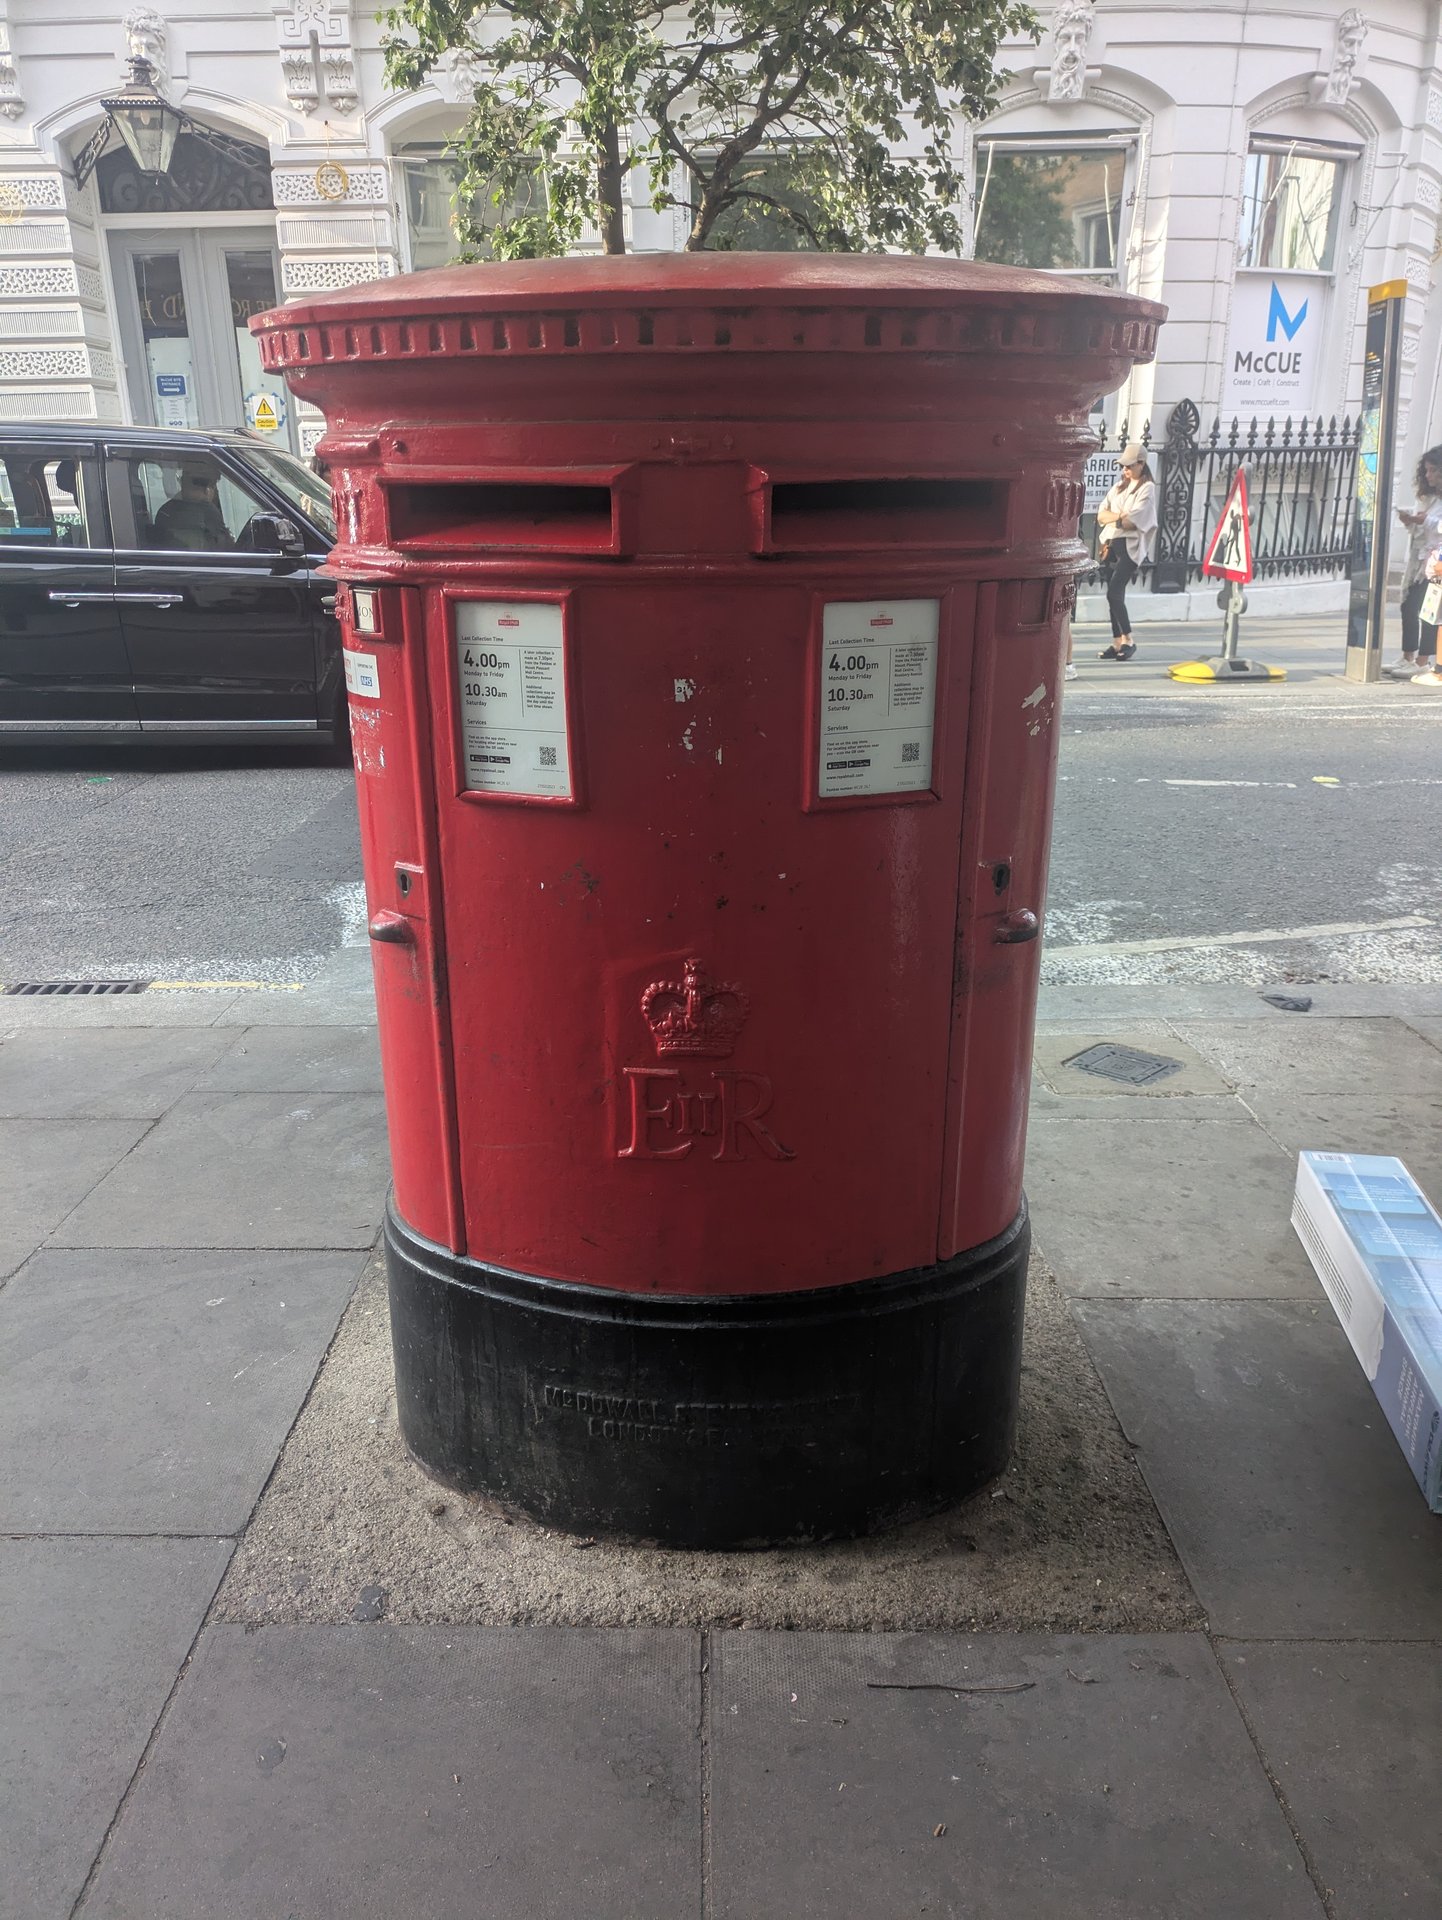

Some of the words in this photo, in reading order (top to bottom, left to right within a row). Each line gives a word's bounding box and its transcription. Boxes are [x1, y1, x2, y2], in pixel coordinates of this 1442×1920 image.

[1234, 351, 1302, 374] McCUE
[1232, 378, 1251, 386] Create
[1257, 378, 1271, 386] Craft
[1276, 379, 1299, 387] Construct
[1240, 398, 1290, 406] www.mccuefit.com
[1085, 459, 1122, 471] RRIC
[1084, 474, 1117, 487] REET
[463, 649, 510, 669] 4.00pm
[829, 653, 879, 671] 4.00pm
[465, 683, 508, 698] 10.30am
[828, 688, 874, 702] 10.30am
